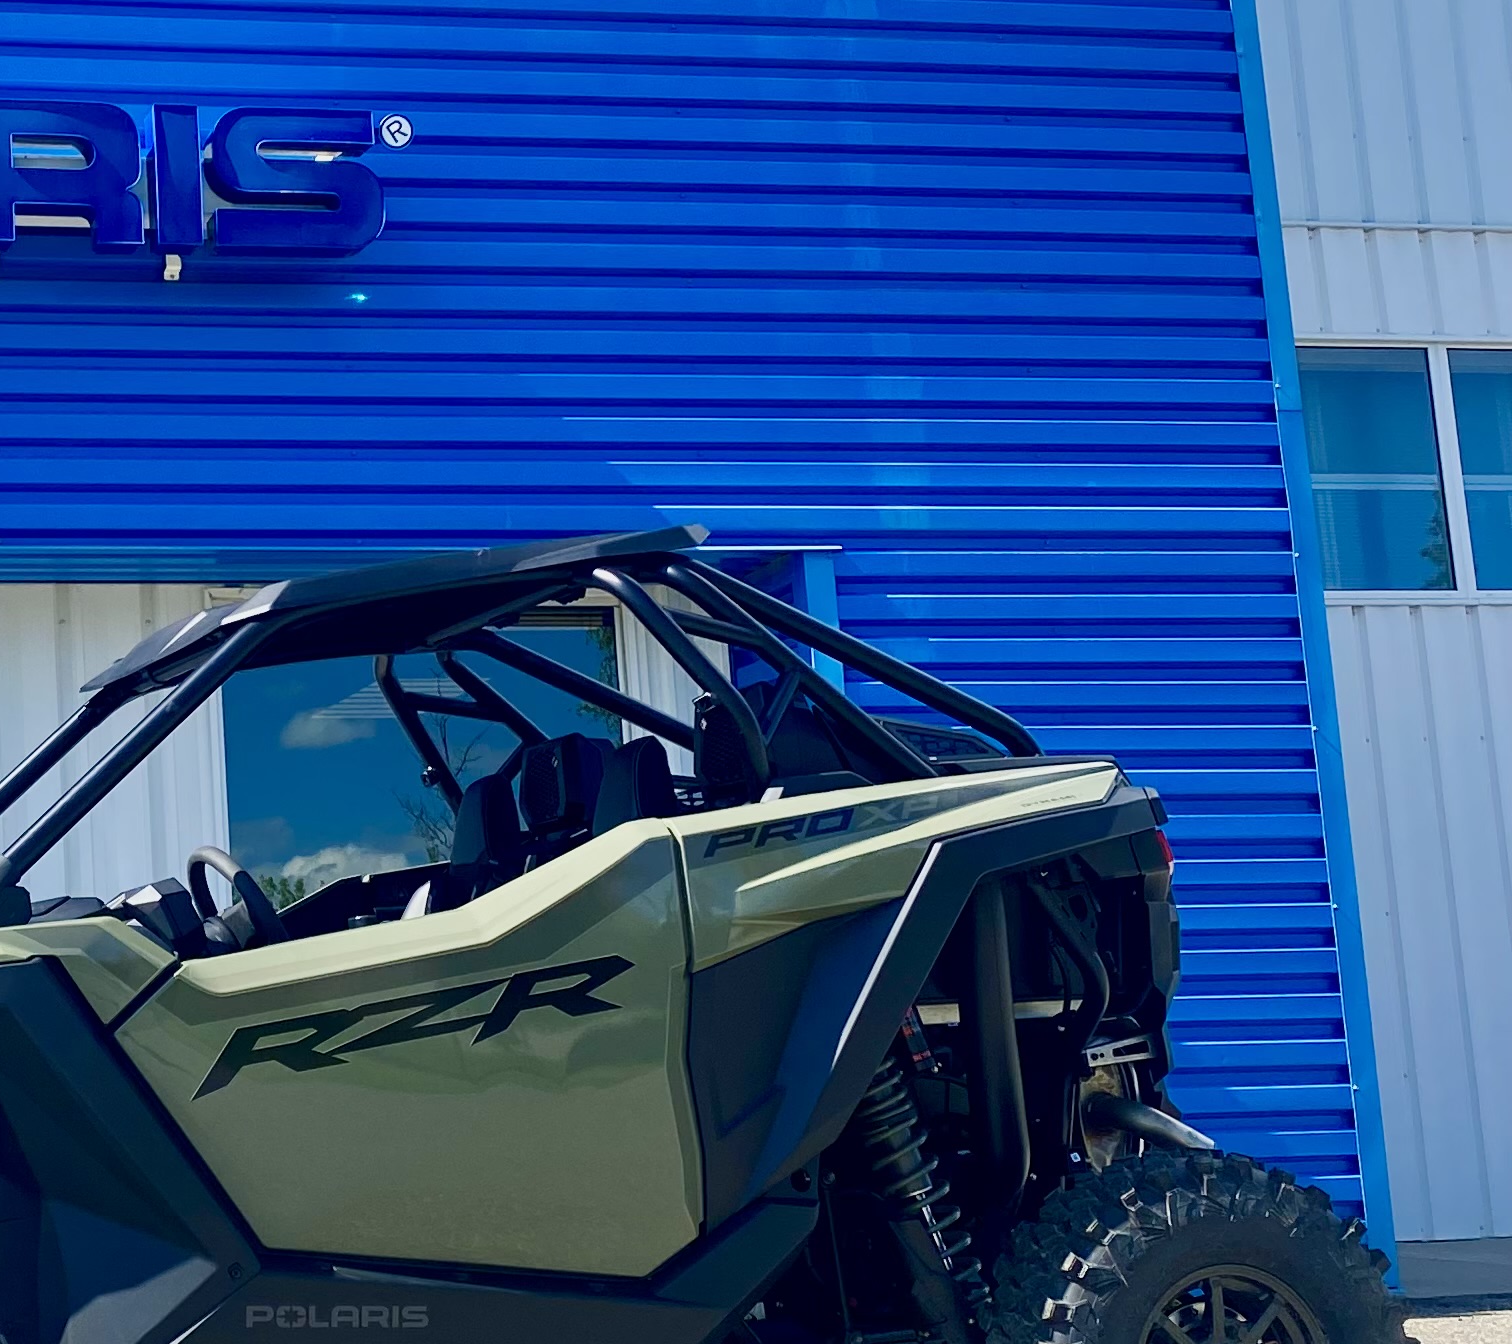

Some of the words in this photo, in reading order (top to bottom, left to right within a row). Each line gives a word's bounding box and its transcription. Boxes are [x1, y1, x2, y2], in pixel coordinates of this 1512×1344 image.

[704, 808, 854, 858] PRO
[858, 794, 938, 826] XP
[190, 954, 636, 1101] RZR
[245, 1305, 429, 1328] POLARIS
